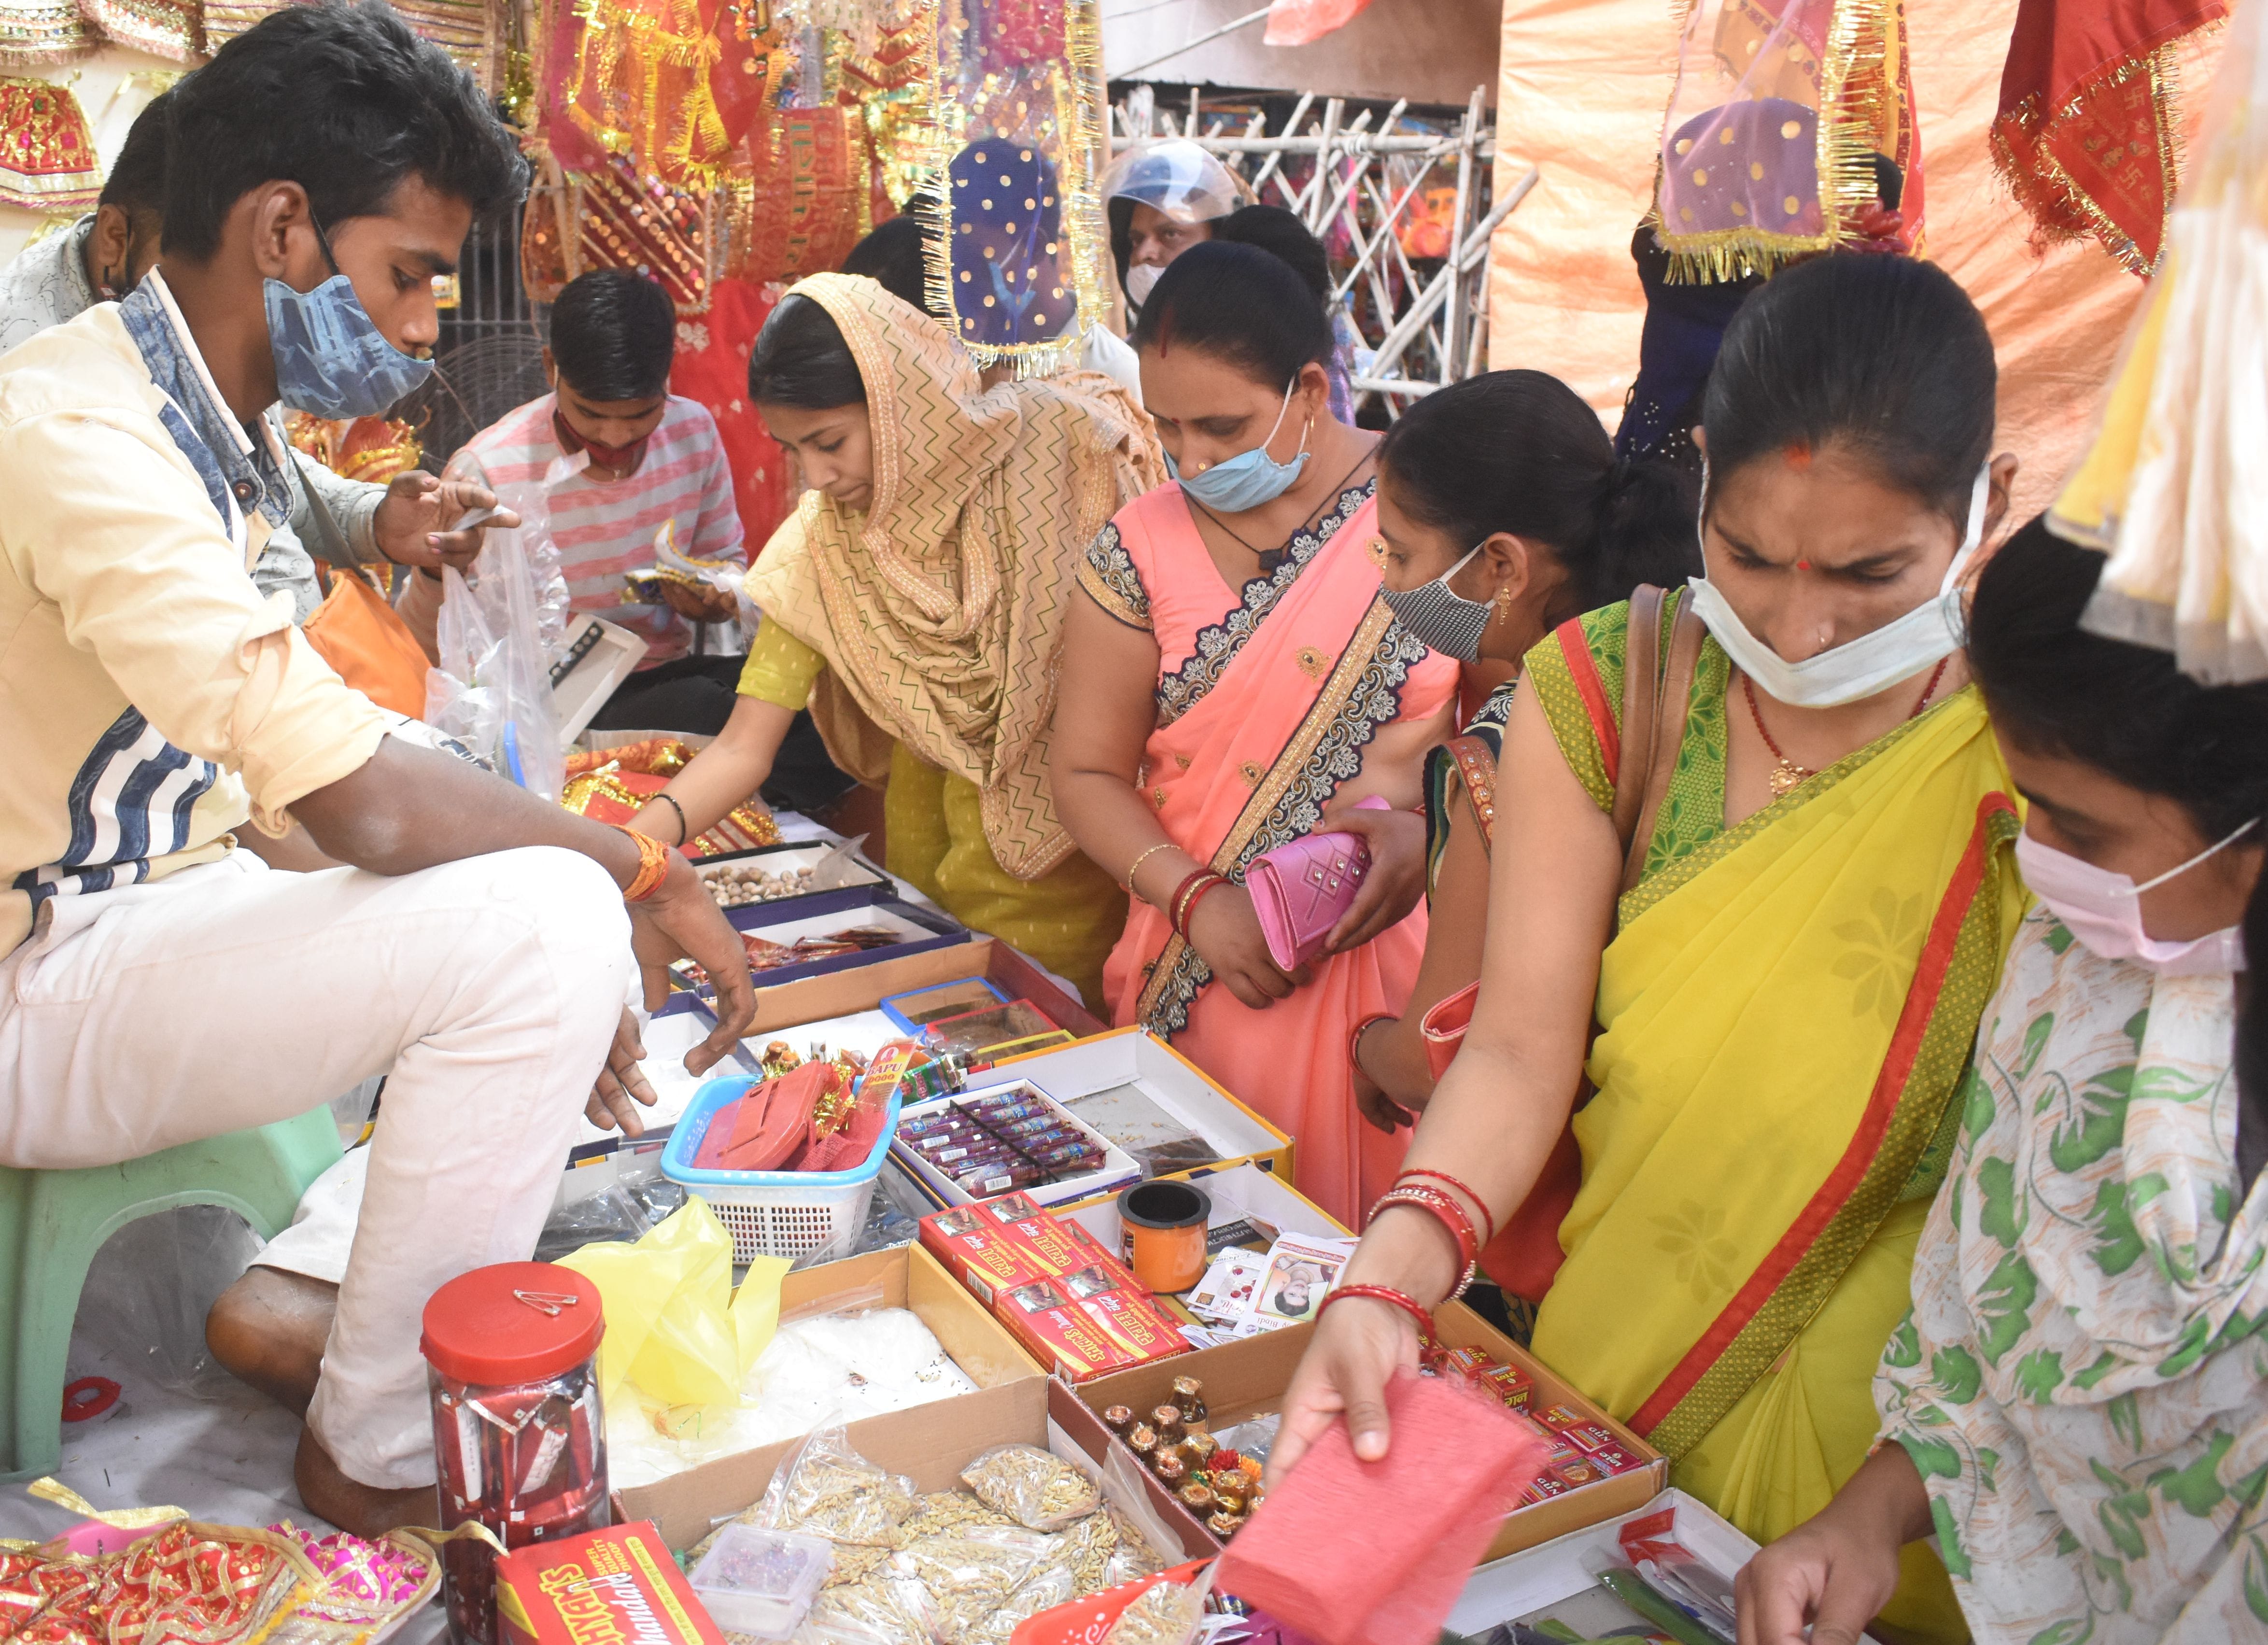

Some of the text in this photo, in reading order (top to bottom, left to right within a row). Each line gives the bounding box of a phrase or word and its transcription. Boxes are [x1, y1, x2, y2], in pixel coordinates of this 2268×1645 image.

[869, 1063, 902, 1075] BAPU
[1257, 1317, 1278, 1328] Bindi
[1063, 1327, 1105, 1363] SHYAM'S
[1467, 1348, 1484, 1363] GUN
[1504, 1392, 1528, 1407] गन
[1588, 1427, 1611, 1442] GUN
[1537, 1477, 1560, 1495] GUN
[586, 1548, 608, 1576] SUPER
[592, 1539, 619, 1574] QUALITY
[608, 1541, 632, 1571] DHOOP
